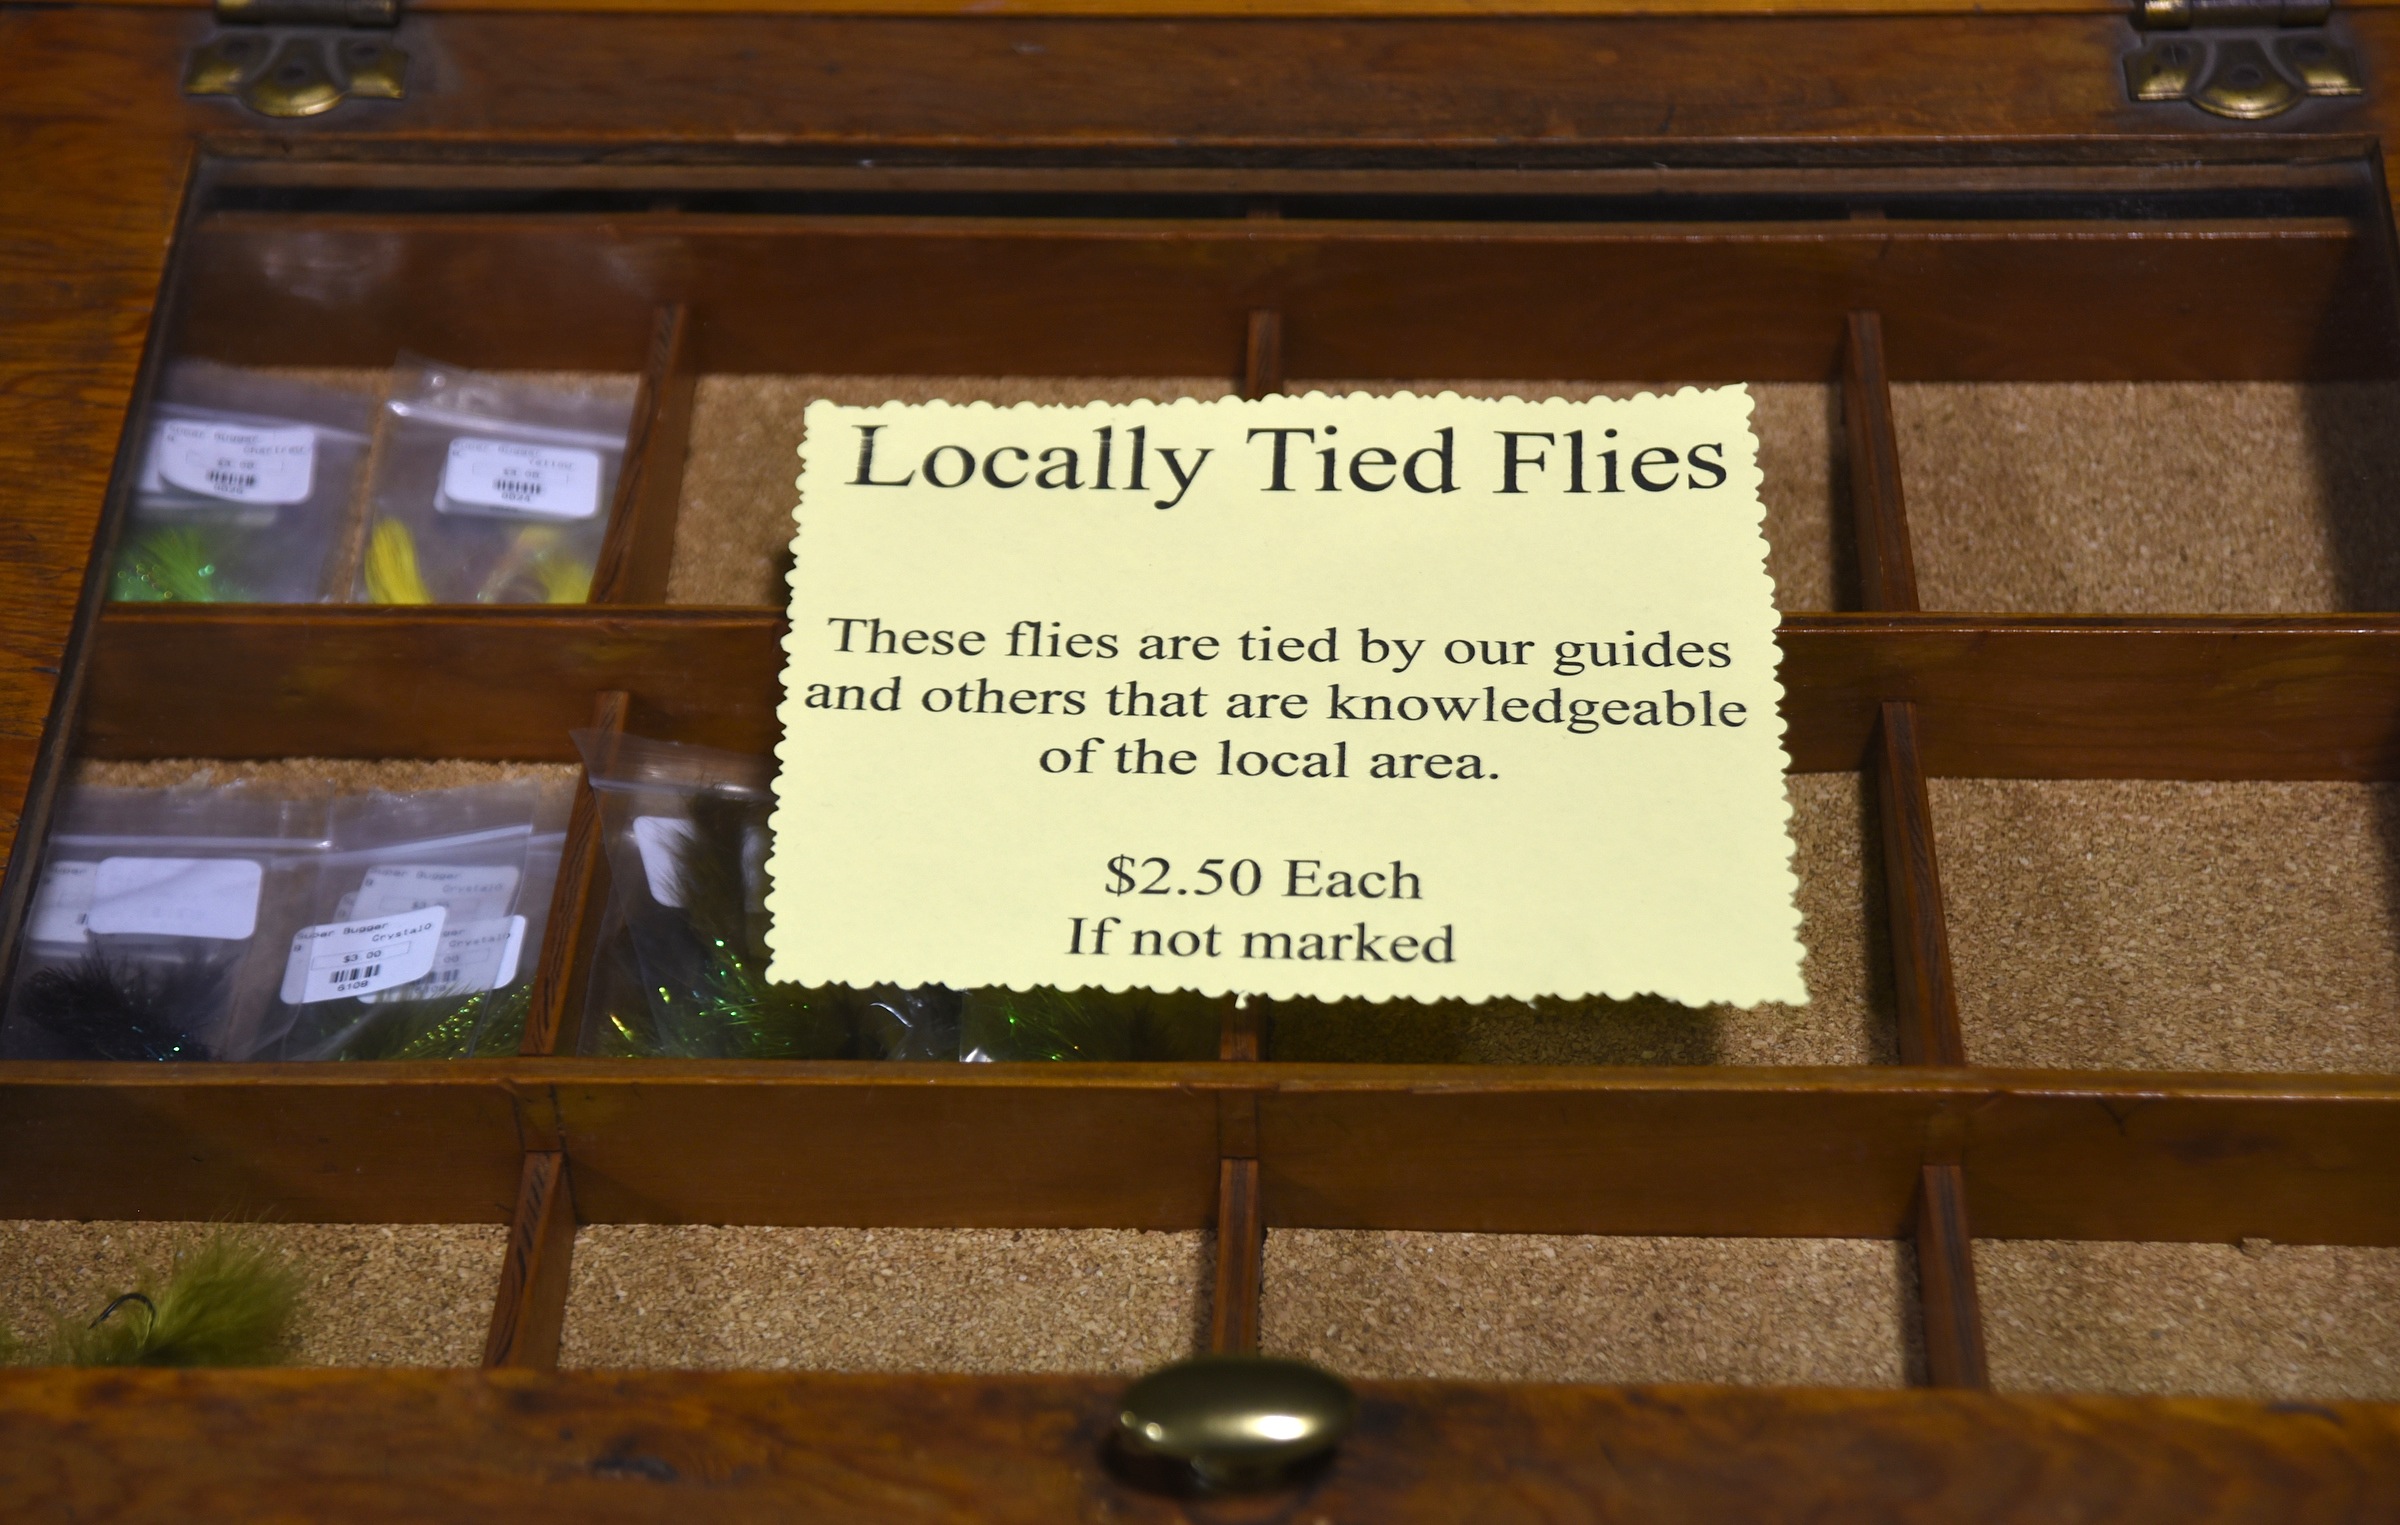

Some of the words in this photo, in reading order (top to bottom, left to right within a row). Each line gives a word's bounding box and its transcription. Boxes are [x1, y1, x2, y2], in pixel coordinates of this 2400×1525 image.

[845, 425, 1214, 510] Locally
[1246, 425, 1461, 494] Tied
[1493, 429, 1727, 495] Flies
[828, 617, 986, 656] These
[1006, 620, 1119, 659] flies
[1139, 635, 1220, 661] are
[1238, 626, 1340, 663] tied
[1357, 627, 1426, 674] by
[1444, 639, 1535, 665] our
[1553, 630, 1732, 677] guides
[804, 675, 902, 712] and
[921, 677, 1086, 716] others
[1106, 680, 1208, 718] that
[1226, 693, 1308, 719] are
[1327, 683, 1747, 735] knowledgeable
[1039, 737, 1105, 774] of
[1114, 738, 1197, 776] the
[1218, 739, 1349, 778] local
[1369, 753, 1499, 780] area.
[1105, 854, 1262, 897] $2.50
[1286, 859, 1421, 900] Each
[343, 921, 391, 935] Bugger
[1069, 916, 1122, 955] If
[1133, 924, 1221, 958] not
[1243, 922, 1455, 964] marked
[342, 949, 383, 964] $300
